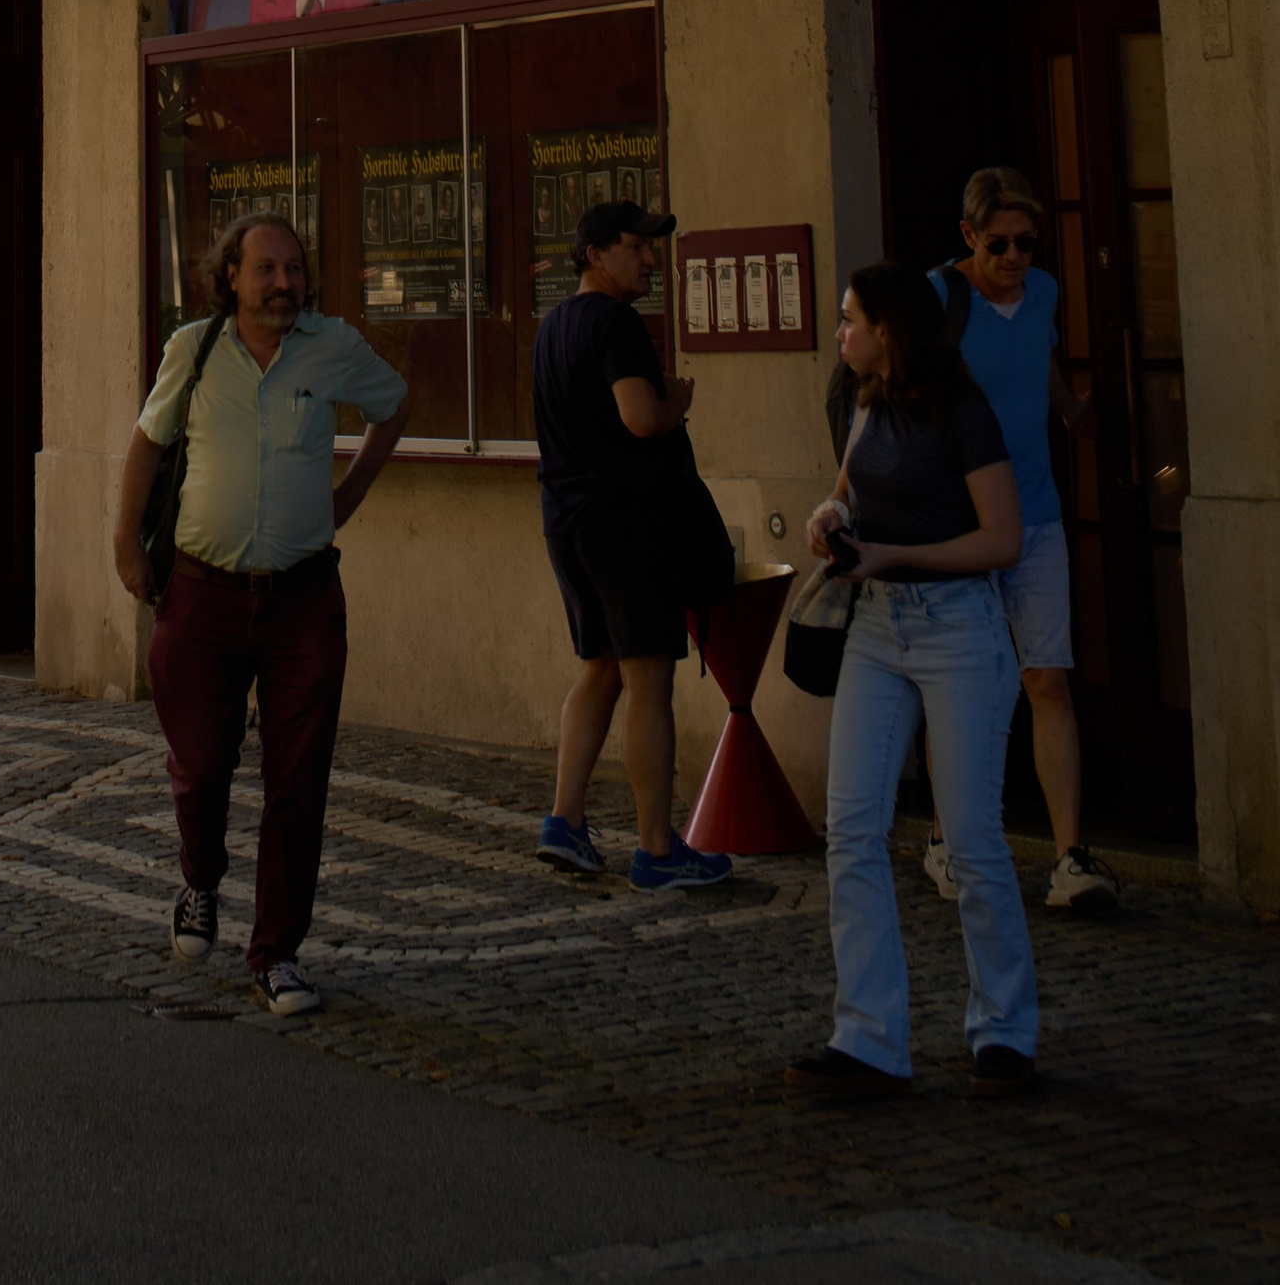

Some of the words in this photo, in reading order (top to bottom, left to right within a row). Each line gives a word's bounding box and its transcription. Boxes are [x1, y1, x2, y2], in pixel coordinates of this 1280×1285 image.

[362, 152, 408, 182] Horrible
[531, 135, 583, 170] Horrible
[208, 166, 250, 193] Horrible
